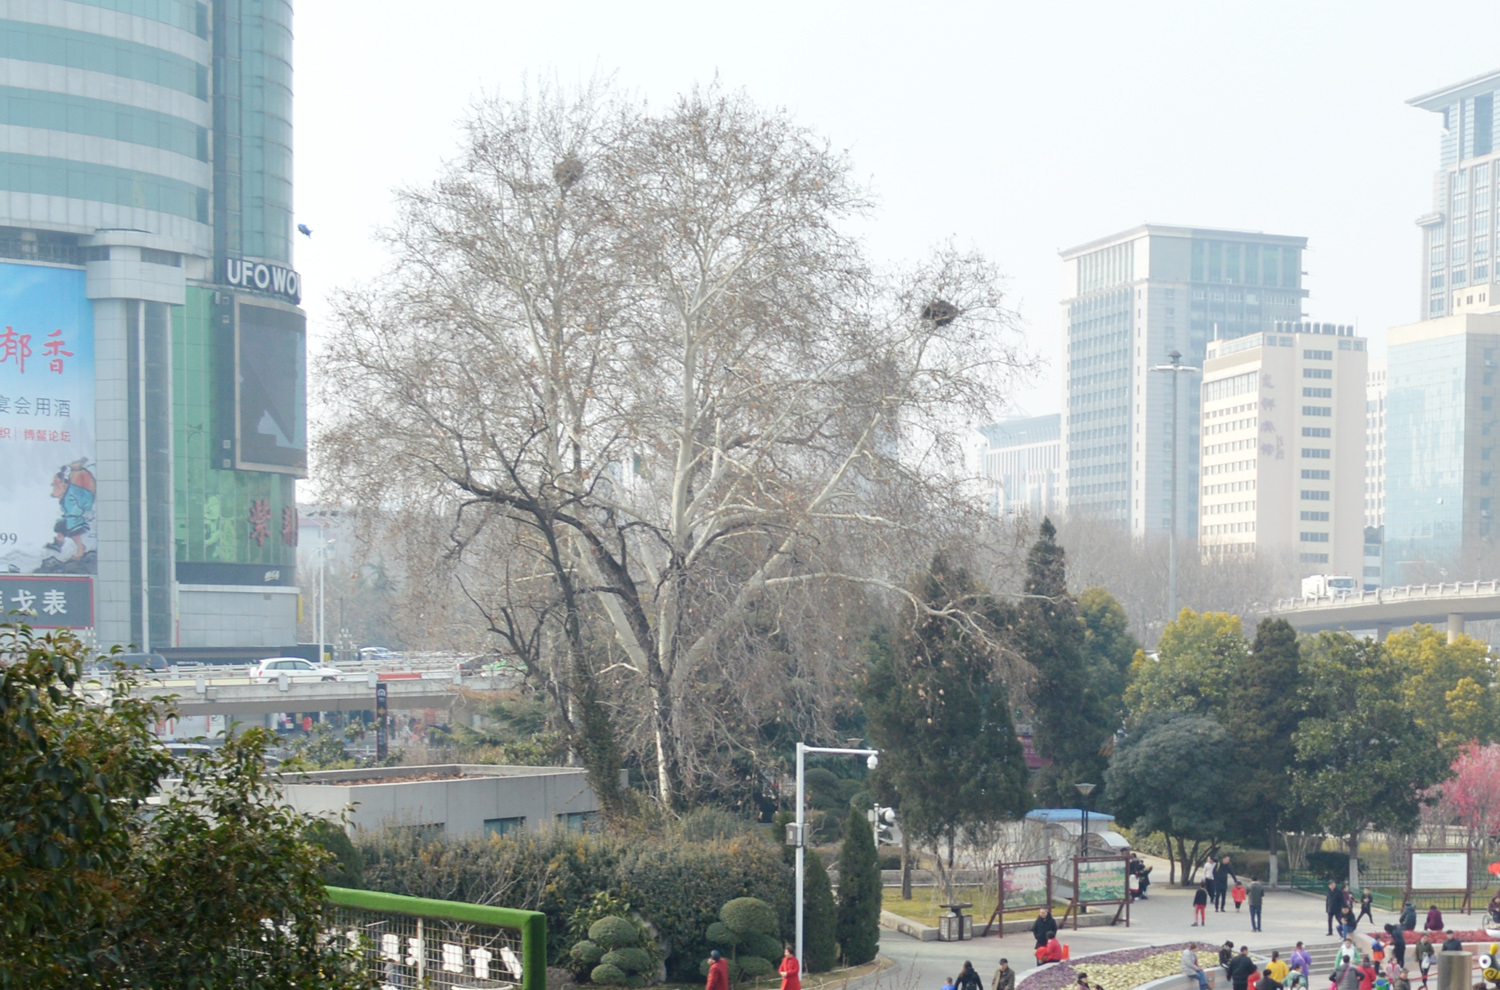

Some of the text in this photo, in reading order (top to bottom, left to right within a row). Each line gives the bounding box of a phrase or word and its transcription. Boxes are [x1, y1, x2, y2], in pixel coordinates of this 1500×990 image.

[227, 258, 270, 289] UFO
[24, 429, 71, 442] 博鳌论坛
